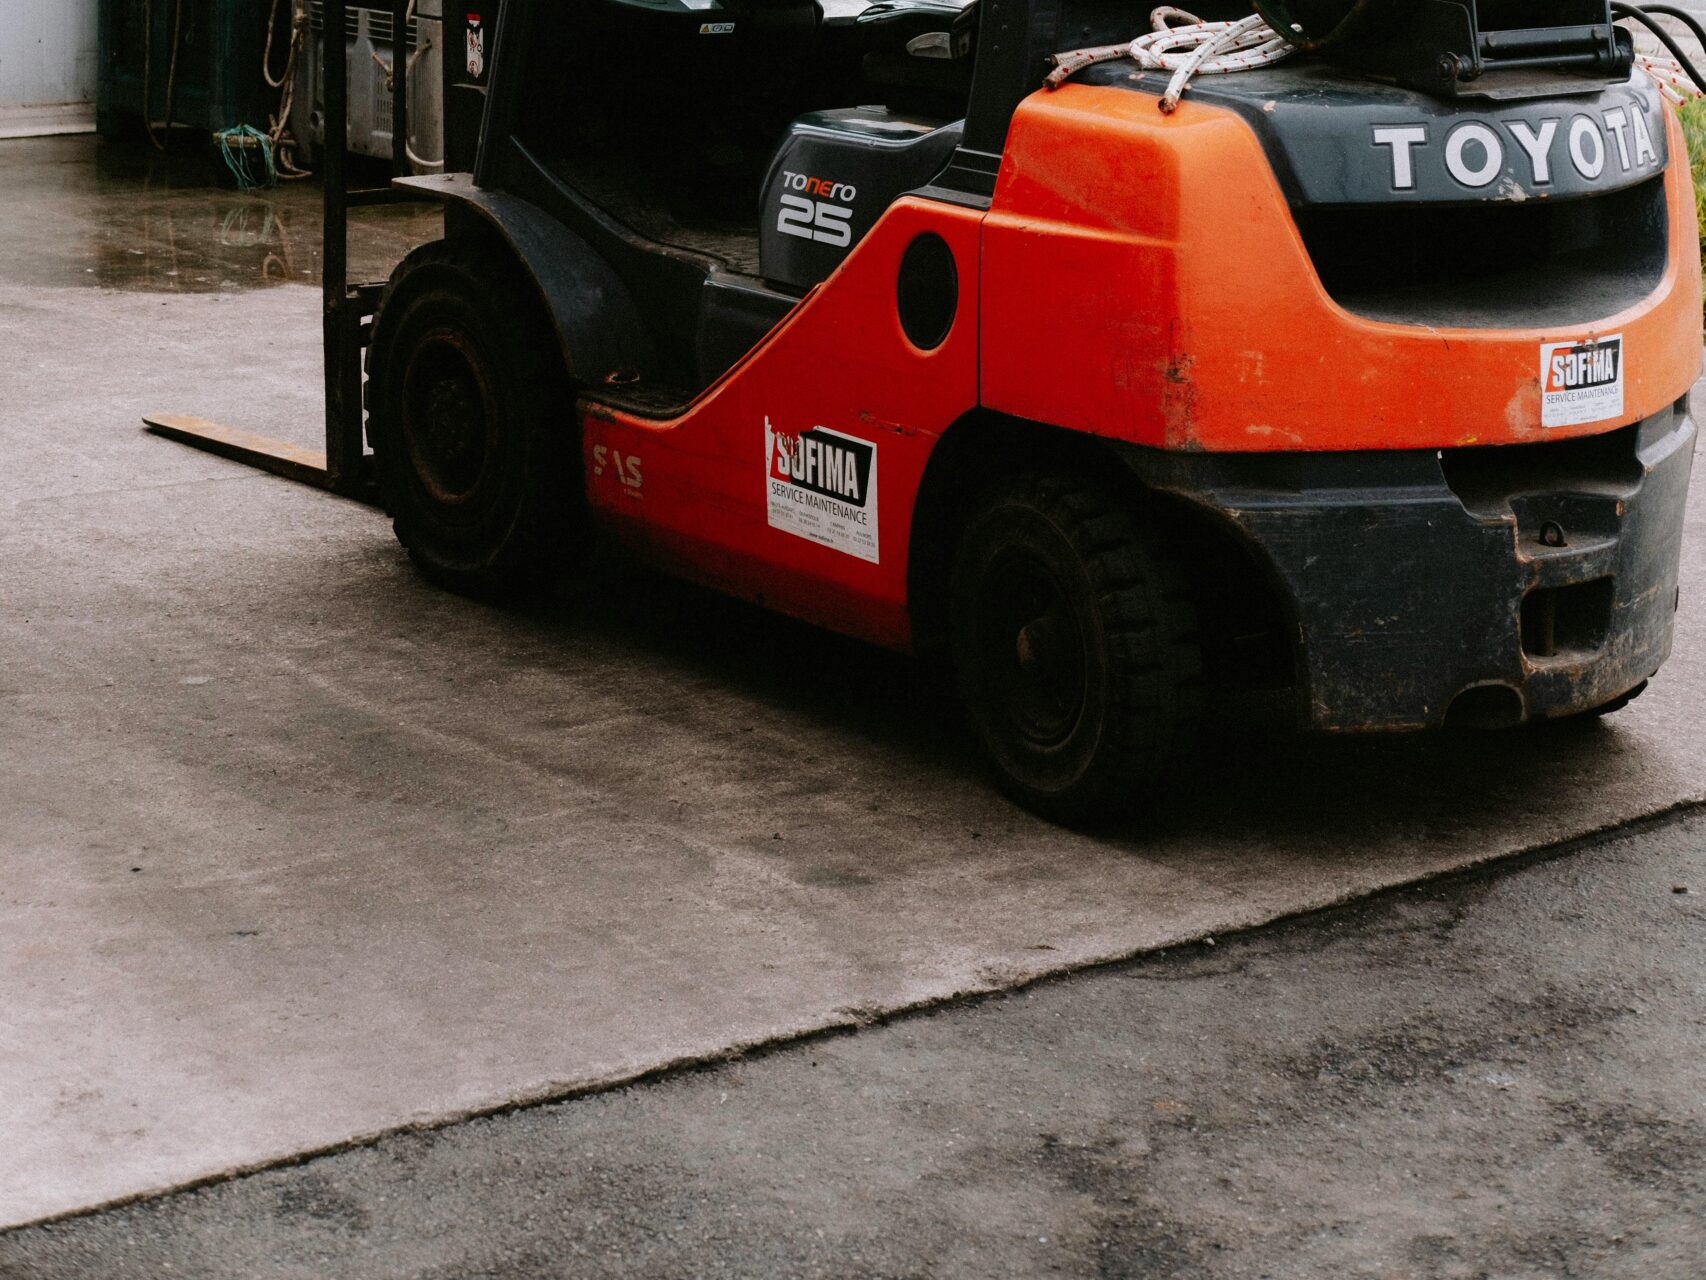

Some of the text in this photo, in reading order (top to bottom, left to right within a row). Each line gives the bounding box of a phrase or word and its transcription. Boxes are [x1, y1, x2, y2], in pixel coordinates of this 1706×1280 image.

[1373, 103, 1657, 188] TOYOTA
[777, 193, 854, 248] 25
[1552, 348, 1615, 387] SOFIMA
[1546, 385, 1618, 405] SERVICE MAINTENANCE
[776, 432, 860, 500] SOFIMA
[771, 481, 804, 505] SERVICE
[805, 493, 868, 526] MAINTENANCE
